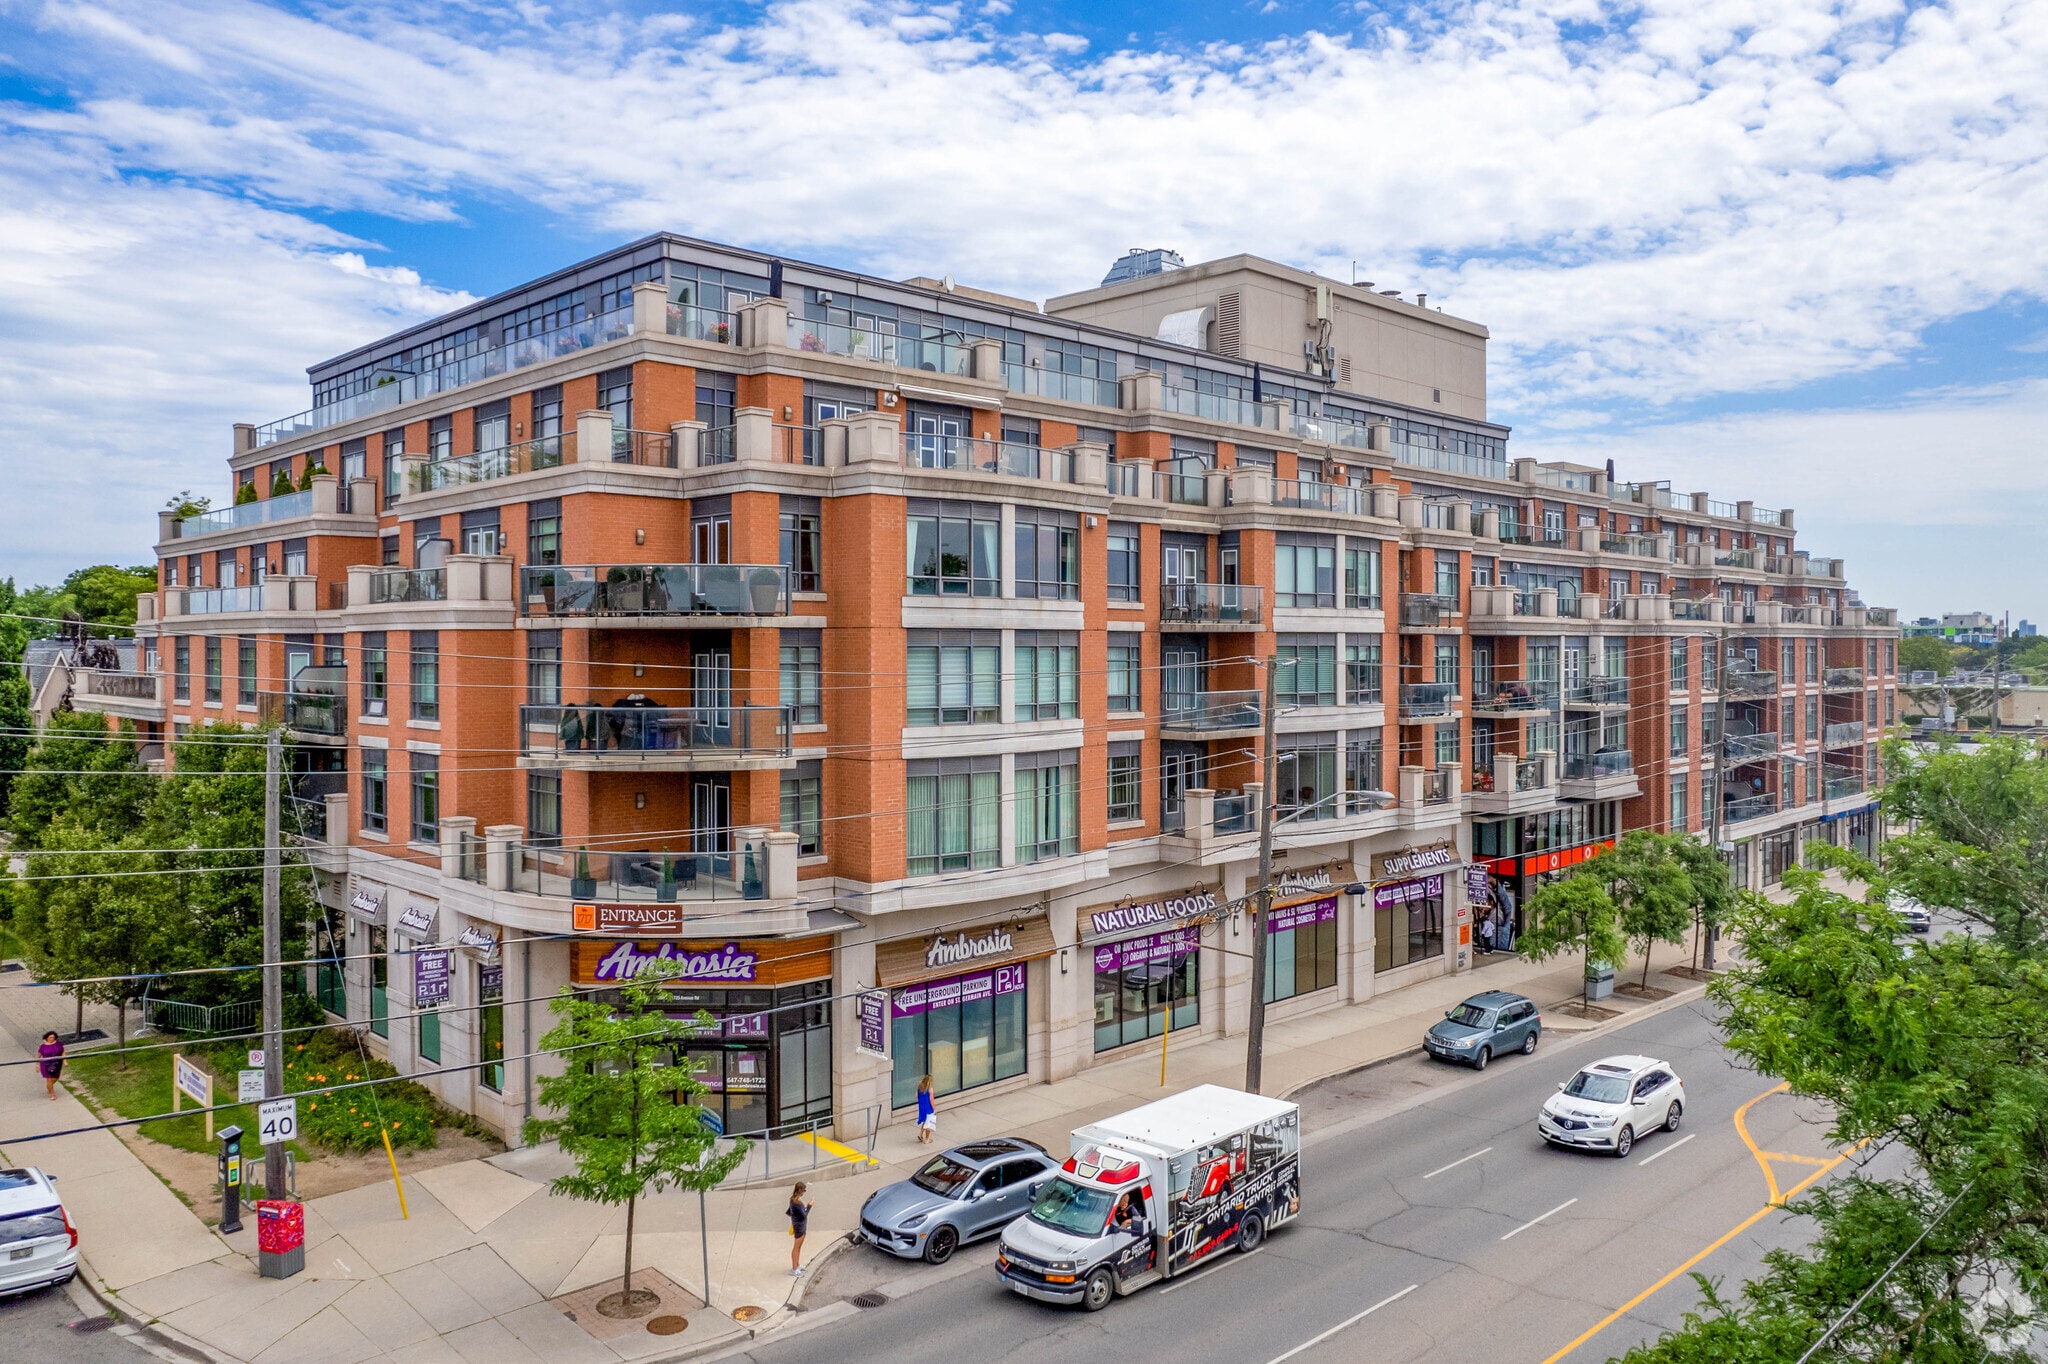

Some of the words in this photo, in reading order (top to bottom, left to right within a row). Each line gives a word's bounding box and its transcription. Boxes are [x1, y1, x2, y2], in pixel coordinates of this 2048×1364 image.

[1384, 848, 1451, 875] SUPPLEMENTS
[1278, 869, 1333, 897] Ambrosia
[399, 907, 431, 931] Ambrosia
[600, 909, 676, 922] ENTRANCE
[1092, 903, 1165, 932] NATURAL
[1165, 894, 1217, 918] FOODS
[927, 929, 1013, 967] Ambrosia
[422, 960, 443, 970] FREE
[597, 942, 754, 978] Ambrosia
[997, 969, 1010, 992] P
[1014, 965, 1022, 984] 1
[430, 983, 436, 993] 1
[898, 995, 913, 1006] FREE
[913, 986, 960, 1001] UNDERGROUND
[963, 979, 988, 992] PARKING
[864, 1004, 879, 1017] FREE
[932, 999, 947, 1009] ENTER
[947, 997, 955, 1006] ON
[731, 1014, 746, 1034] P
[752, 1015, 761, 1031] 1
[262, 1104, 292, 1115] MAXIMUM
[262, 1117, 292, 1137] 40
[1207, 1191, 1245, 1224] ONTARIO
[1245, 1171, 1273, 1197] TRUCK
[1243, 1180, 1276, 1210] CENTRE
